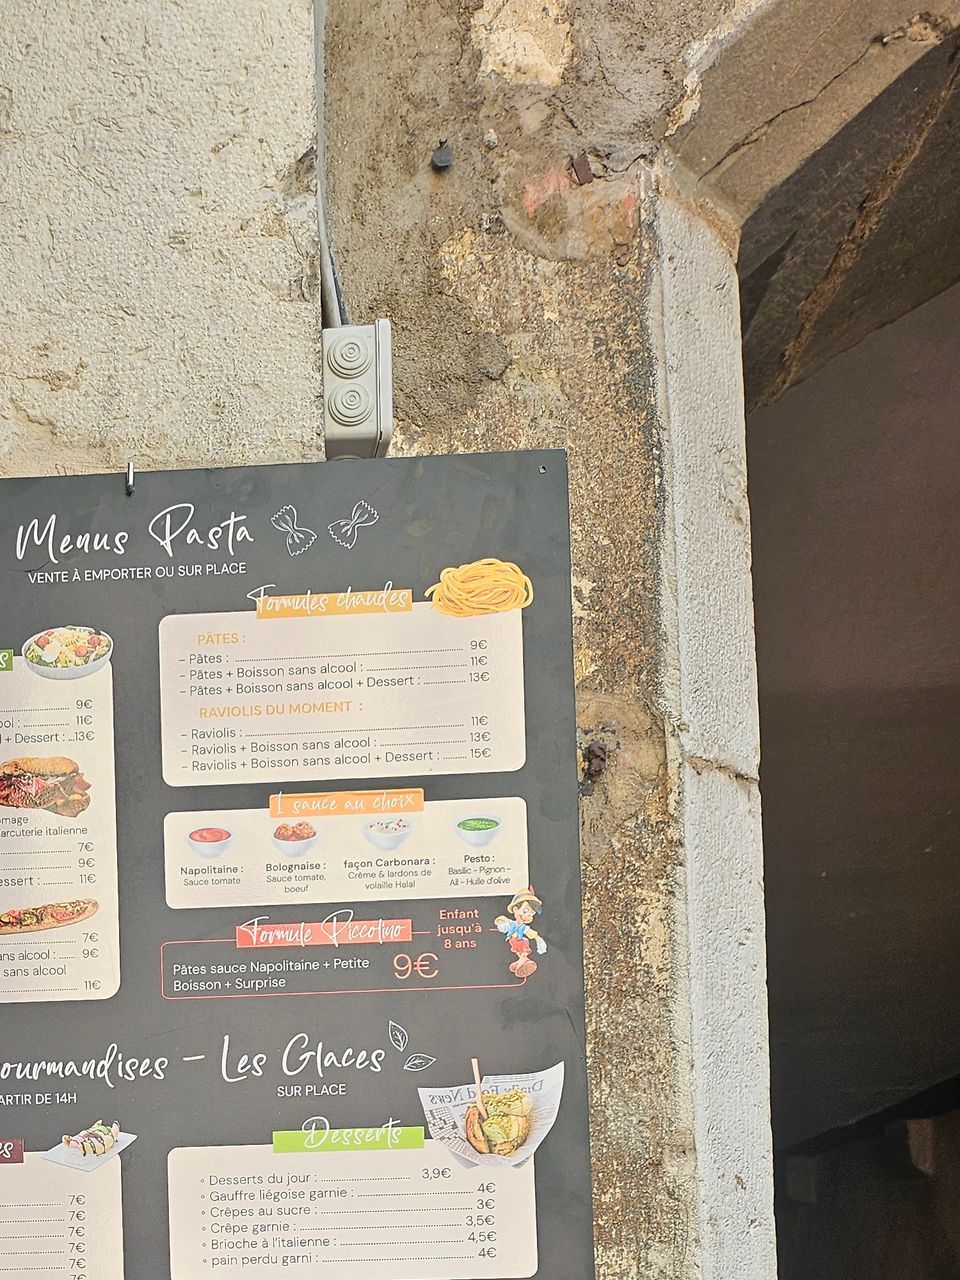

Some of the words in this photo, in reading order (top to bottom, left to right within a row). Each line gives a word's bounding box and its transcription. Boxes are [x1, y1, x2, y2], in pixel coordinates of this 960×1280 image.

[16, 514, 129, 563] Menus
[149, 503, 254, 557] Pasta
[28, 569, 67, 584] VENTE
[72, 566, 81, 582] À
[83, 564, 152, 582] EMPORTER
[156, 564, 174, 578] OU
[178, 564, 202, 577] SUR
[206, 562, 246, 575] PLACE
[247, 584, 328, 615] Formules
[336, 581, 408, 609] chaudes
[197, 632, 239, 644] PÂTES
[76, 699, 93, 710] 9€
[199, 705, 261, 718] RAVIOLIS
[265, 705, 285, 716] DU
[289, 701, 353, 714] MOMENT
[275, 791, 283, 815] 1
[293, 797, 336, 814] sauce
[345, 798, 366, 811] au
[372, 793, 416, 809] choix
[343, 859, 374, 870] façon
[376, 857, 430, 868] Carbonara
[464, 854, 491, 864] Pesto
[180, 864, 240, 877] Napolitaine
[266, 862, 322, 874] Bolognaise
[440, 909, 479, 920] Enfant
[239, 916, 313, 946] Formule
[444, 939, 451, 948] 8
[455, 940, 477, 948] ans
[393, 953, 439, 979] 9€
[221, 1034, 267, 1083] Les
[281, 1033, 389, 1077] Glaces
[277, 1084, 301, 1098] SUR
[305, 1083, 346, 1096] PLACE
[35, 1093, 52, 1105] DE
[55, 1092, 77, 1104] 14H
[302, 1116, 401, 1149] Desserts
[68, 1195, 85, 1205] 7€
[211, 1237, 257, 1249] Brioche
[261, 1237, 268, 1248] à
[467, 1230, 496, 1243] 4,5€
